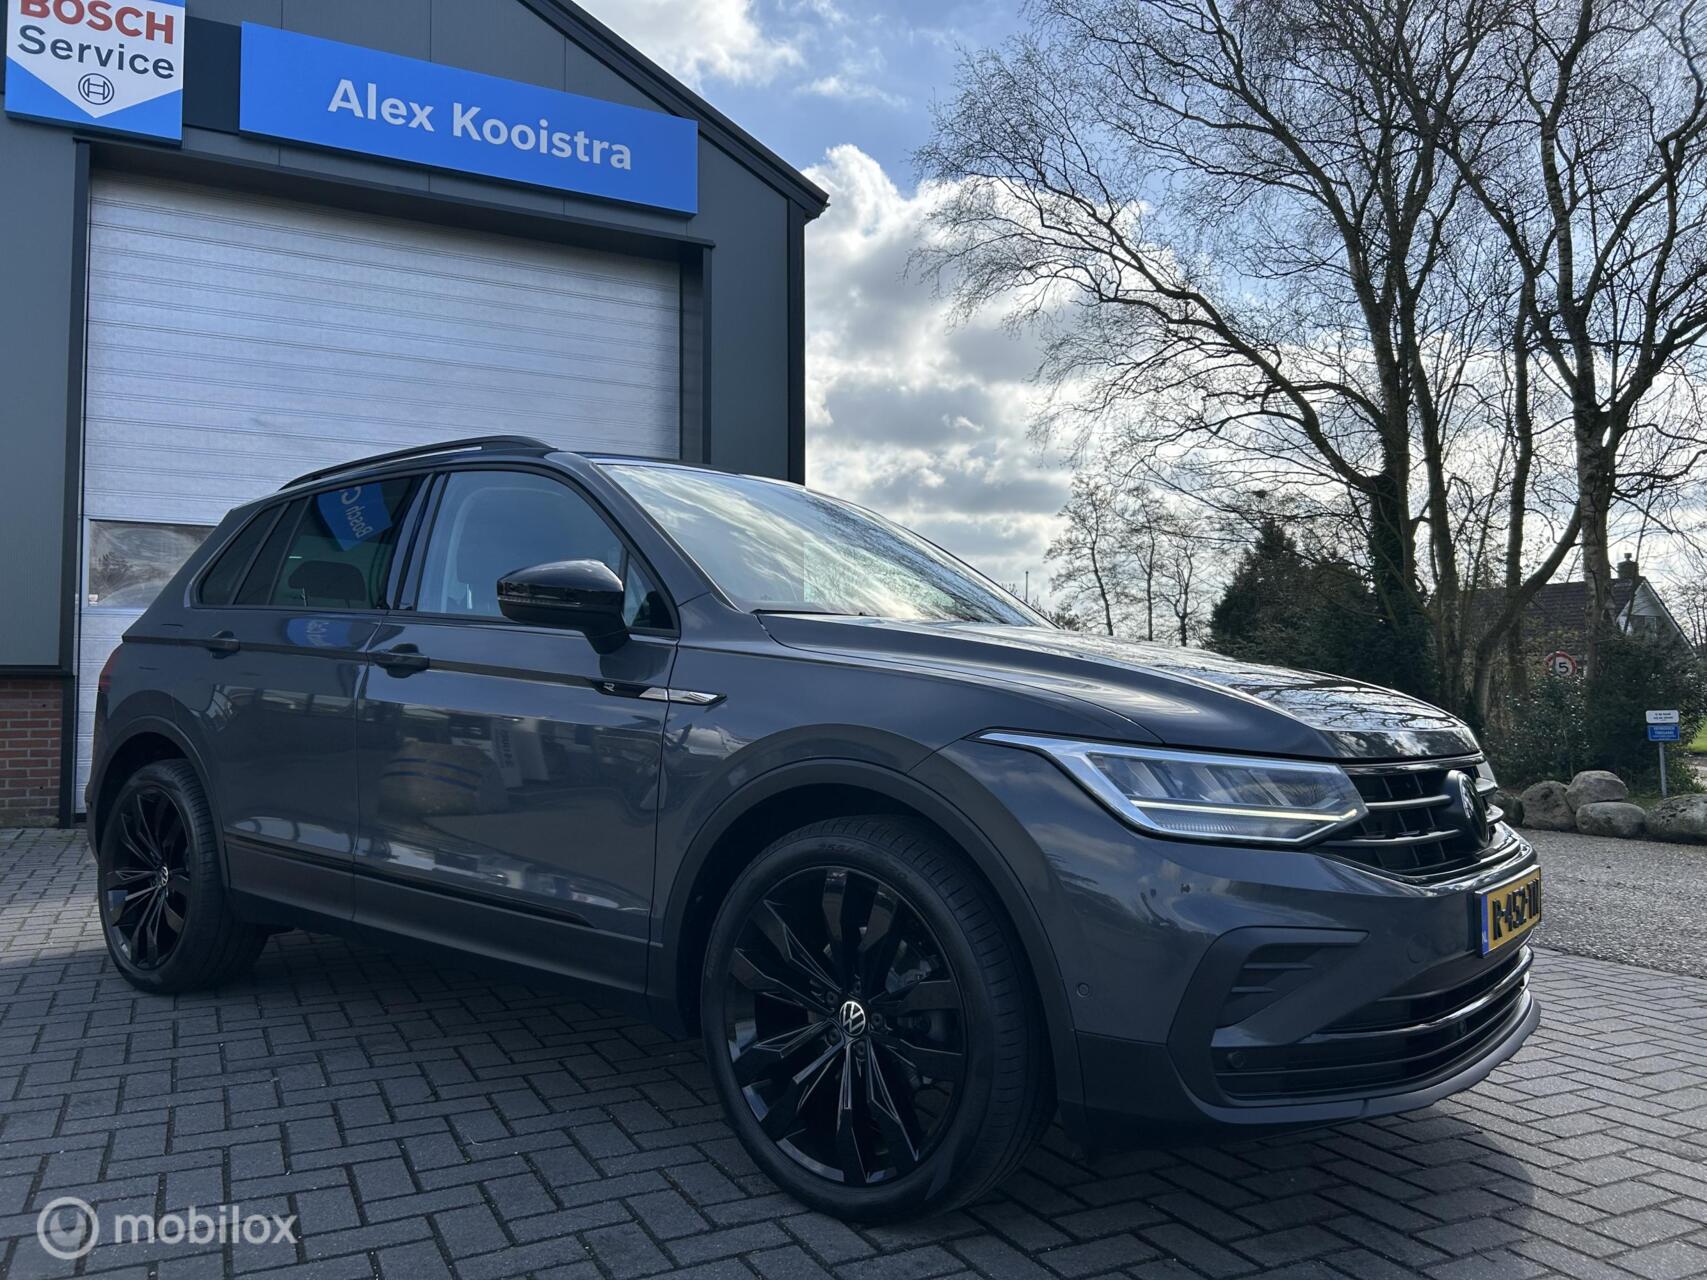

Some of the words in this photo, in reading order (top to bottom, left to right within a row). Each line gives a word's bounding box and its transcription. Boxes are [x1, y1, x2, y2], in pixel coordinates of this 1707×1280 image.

[20, 0, 174, 45] BOSCH
[17, 24, 175, 80] Service
[327, 78, 435, 132] Alex
[452, 102, 632, 171] Kooistra
